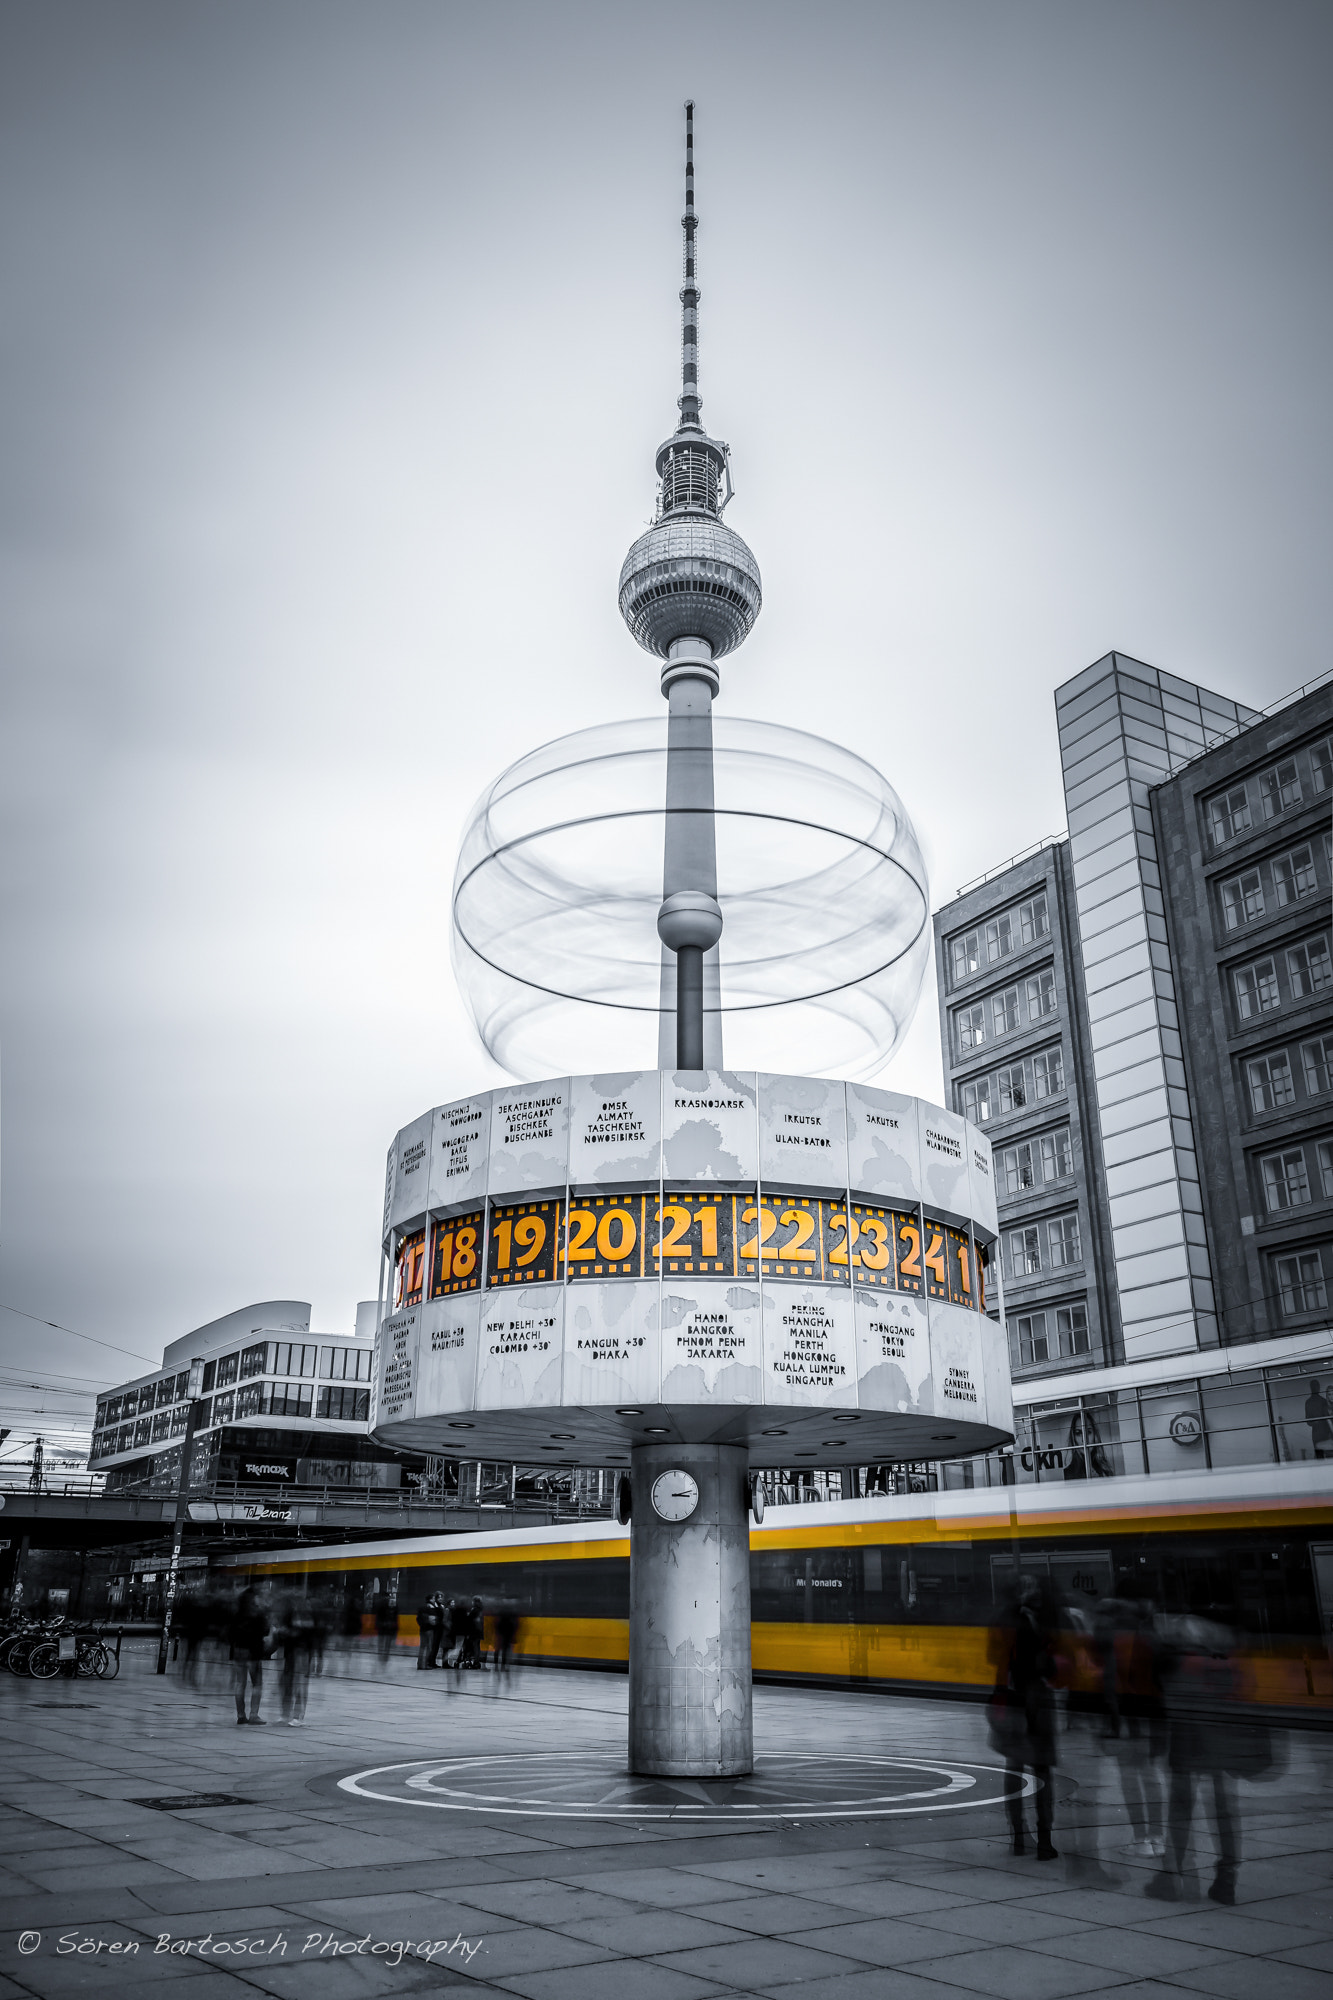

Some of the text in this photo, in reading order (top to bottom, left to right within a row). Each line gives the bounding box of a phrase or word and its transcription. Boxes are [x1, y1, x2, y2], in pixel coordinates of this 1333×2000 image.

[498, 1096, 562, 1114] JEKATERINBURG
[602, 1101, 628, 1111] OMSK
[674, 1099, 745, 1109] KRASNOJARSK
[441, 1105, 470, 1120] NISCHNIJ
[505, 1108, 554, 1123] ASCHGABAT
[596, 1111, 634, 1122] ALMATY
[450, 1111, 482, 1127] NOWGOROD
[784, 1114, 822, 1126] IRKUTSK
[866, 1114, 899, 1129] JAKUTSK
[509, 1119, 548, 1132] BISCHKEK
[587, 1121, 643, 1133] TASCHKENT
[442, 1132, 479, 1148] WOLGOGRAD
[504, 1129, 553, 1143] DUSCHANBE
[584, 1132, 646, 1144] NOWOSIBIRSK
[775, 1134, 832, 1148] ULAN-BATOR
[925, 1129, 961, 1150] CHABAROWSK
[451, 1145, 468, 1156] BAKU
[925, 1138, 962, 1159] WLADIWOSTOK
[446, 1165, 470, 1177] ERIWAN
[407, 1242, 425, 1293] 17
[439, 1227, 477, 1281] 18
[493, 1215, 547, 1270] 19
[559, 1208, 637, 1262] 20
[652, 1205, 718, 1257] 21
[740, 1207, 817, 1262] 22
[829, 1214, 890, 1270] 23
[900, 1226, 945, 1283] 24
[957, 1245, 971, 1294] 1
[791, 1305, 825, 1315] PEKING
[694, 1314, 728, 1323] HANOI
[782, 1316, 835, 1328] SHANGHAI
[486, 1322, 505, 1332] NEW
[509, 1319, 534, 1330] DELHI
[687, 1325, 735, 1335] BANGKOK
[869, 1322, 915, 1337] PJÖNGJANG
[431, 1329, 451, 1341] KABUL
[500, 1331, 541, 1342] KARACHI
[789, 1328, 828, 1339] MANILA
[431, 1338, 464, 1352] MAURITIUS
[577, 1338, 619, 1349] RANGUN
[677, 1337, 746, 1347] PHNOM PENH
[795, 1340, 824, 1350] PERTH
[882, 1335, 905, 1346] TOKYO
[489, 1343, 528, 1355] COLOMBO
[593, 1350, 630, 1360] DHAKA
[687, 1349, 735, 1359] JAKARTA
[882, 1347, 906, 1358] SEOUL
[783, 1351, 836, 1362] HONGKONG
[773, 1362, 846, 1375] KUALA LUMPUR
[949, 1367, 969, 1379] SYDNEY
[786, 1375, 834, 1386] SINGAPUR
[944, 1378, 975, 1391] CANBERRA
[943, 1388, 977, 1402] MELBOURNE
[1174, 1420, 1196, 1436] C&A
[1072, 1570, 1095, 1589] dm
